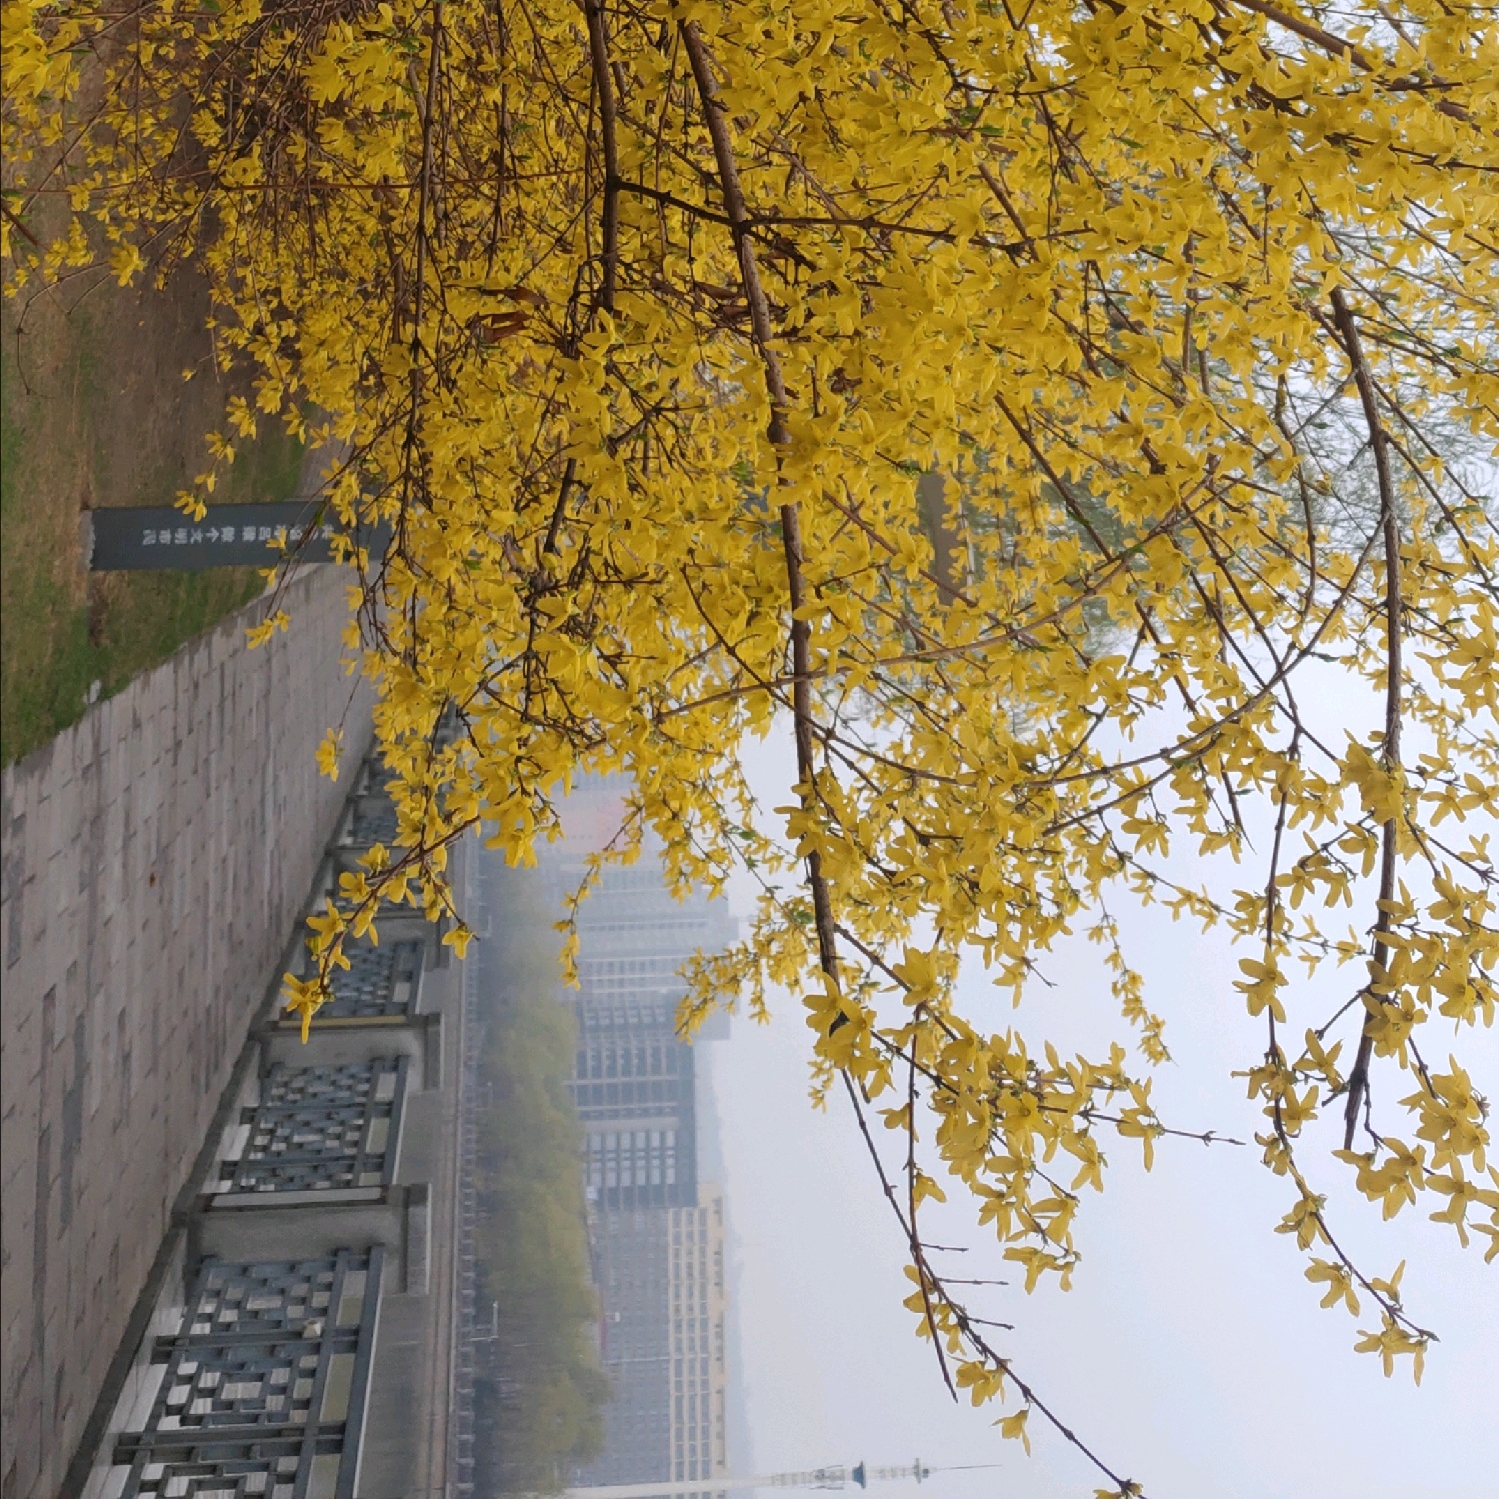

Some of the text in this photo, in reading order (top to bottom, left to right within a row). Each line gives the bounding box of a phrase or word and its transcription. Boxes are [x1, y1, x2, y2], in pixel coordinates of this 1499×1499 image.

[142, 526, 235, 545] 做个文明市民
